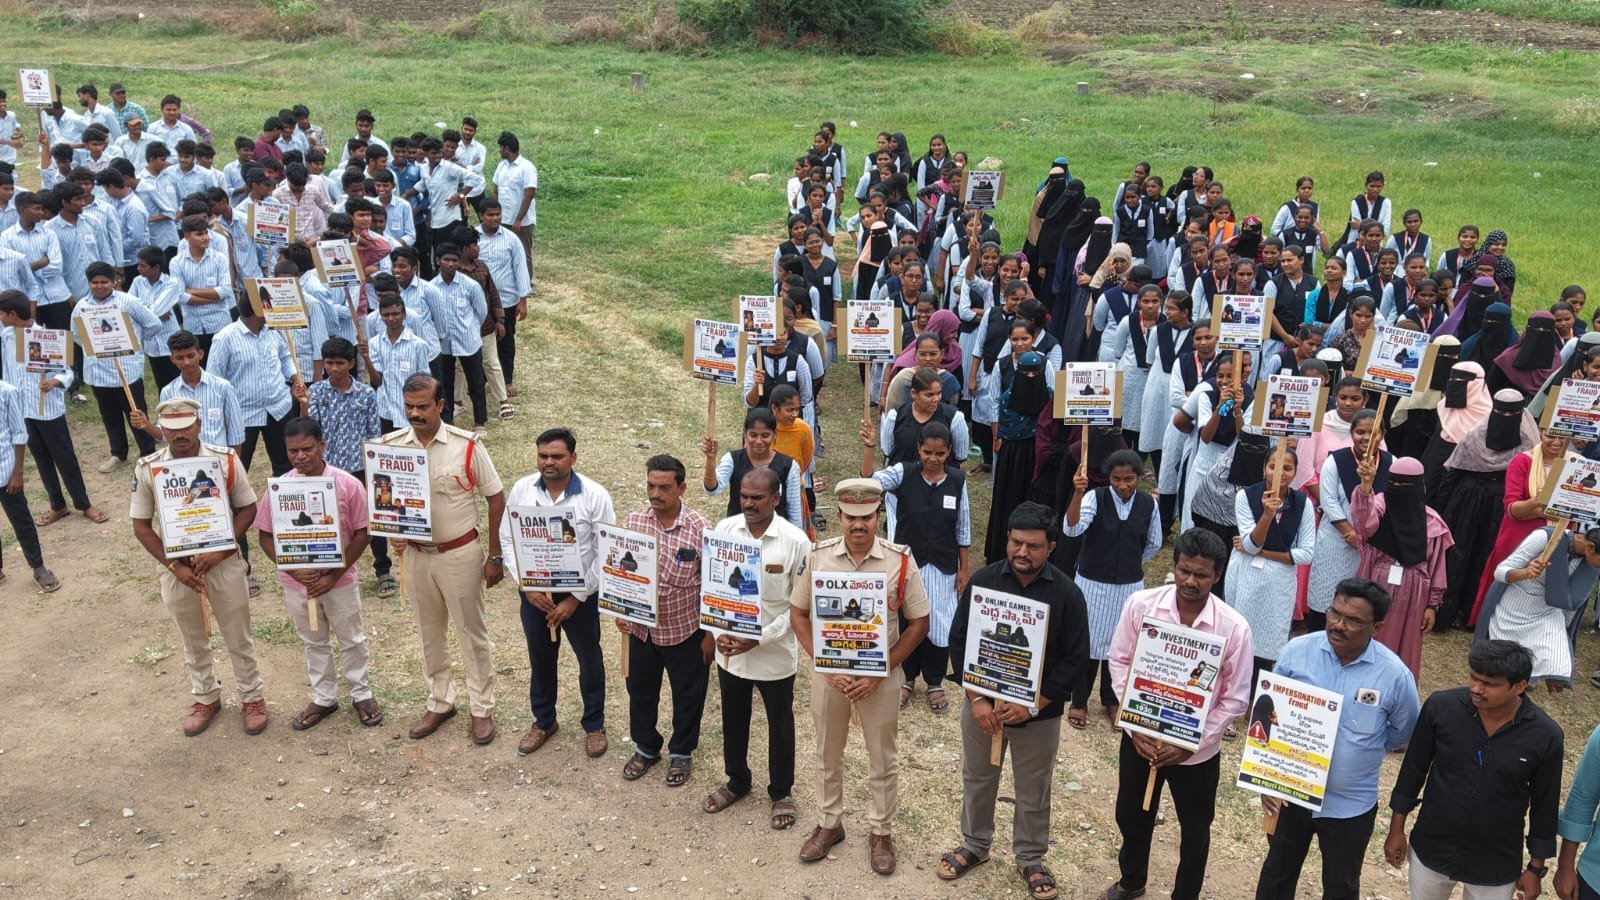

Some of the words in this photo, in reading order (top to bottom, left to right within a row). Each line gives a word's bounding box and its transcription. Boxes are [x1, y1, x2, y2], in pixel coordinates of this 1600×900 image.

[702, 320, 719, 329] CREDIT
[33, 333, 57, 341] FRAUD
[706, 327, 727, 337] FRAUD
[1389, 334, 1414, 346] FRAUD
[1280, 382, 1309, 392] FRAUD
[1577, 387, 1598, 396] FRAUD
[379, 459, 415, 472] FRAUD
[163, 477, 187, 490] JOB
[163, 487, 191, 499] FRAUD
[279, 494, 306, 502] COURIER
[280, 502, 306, 511] FRAUD
[519, 516, 547, 528] LOAN
[520, 527, 549, 539] FRAUD
[615, 540, 640, 553] FRAUD
[710, 538, 734, 550] CREDIT
[734, 543, 753, 554] CARD
[717, 548, 745, 563] FRAUD
[826, 580, 848, 590] OLX
[984, 597, 1009, 608] ONLINE
[1009, 602, 1032, 613] GAMES
[1159, 632, 1210, 651] INVESTMENT
[1164, 643, 1199, 660] FRAUD
[1273, 684, 1327, 708] IMPERSONATION
[1136, 703, 1152, 714] 1930
[1288, 697, 1309, 710] Fraud
[1121, 711, 1140, 724] NTR
[1140, 716, 1160, 727] POLICE
